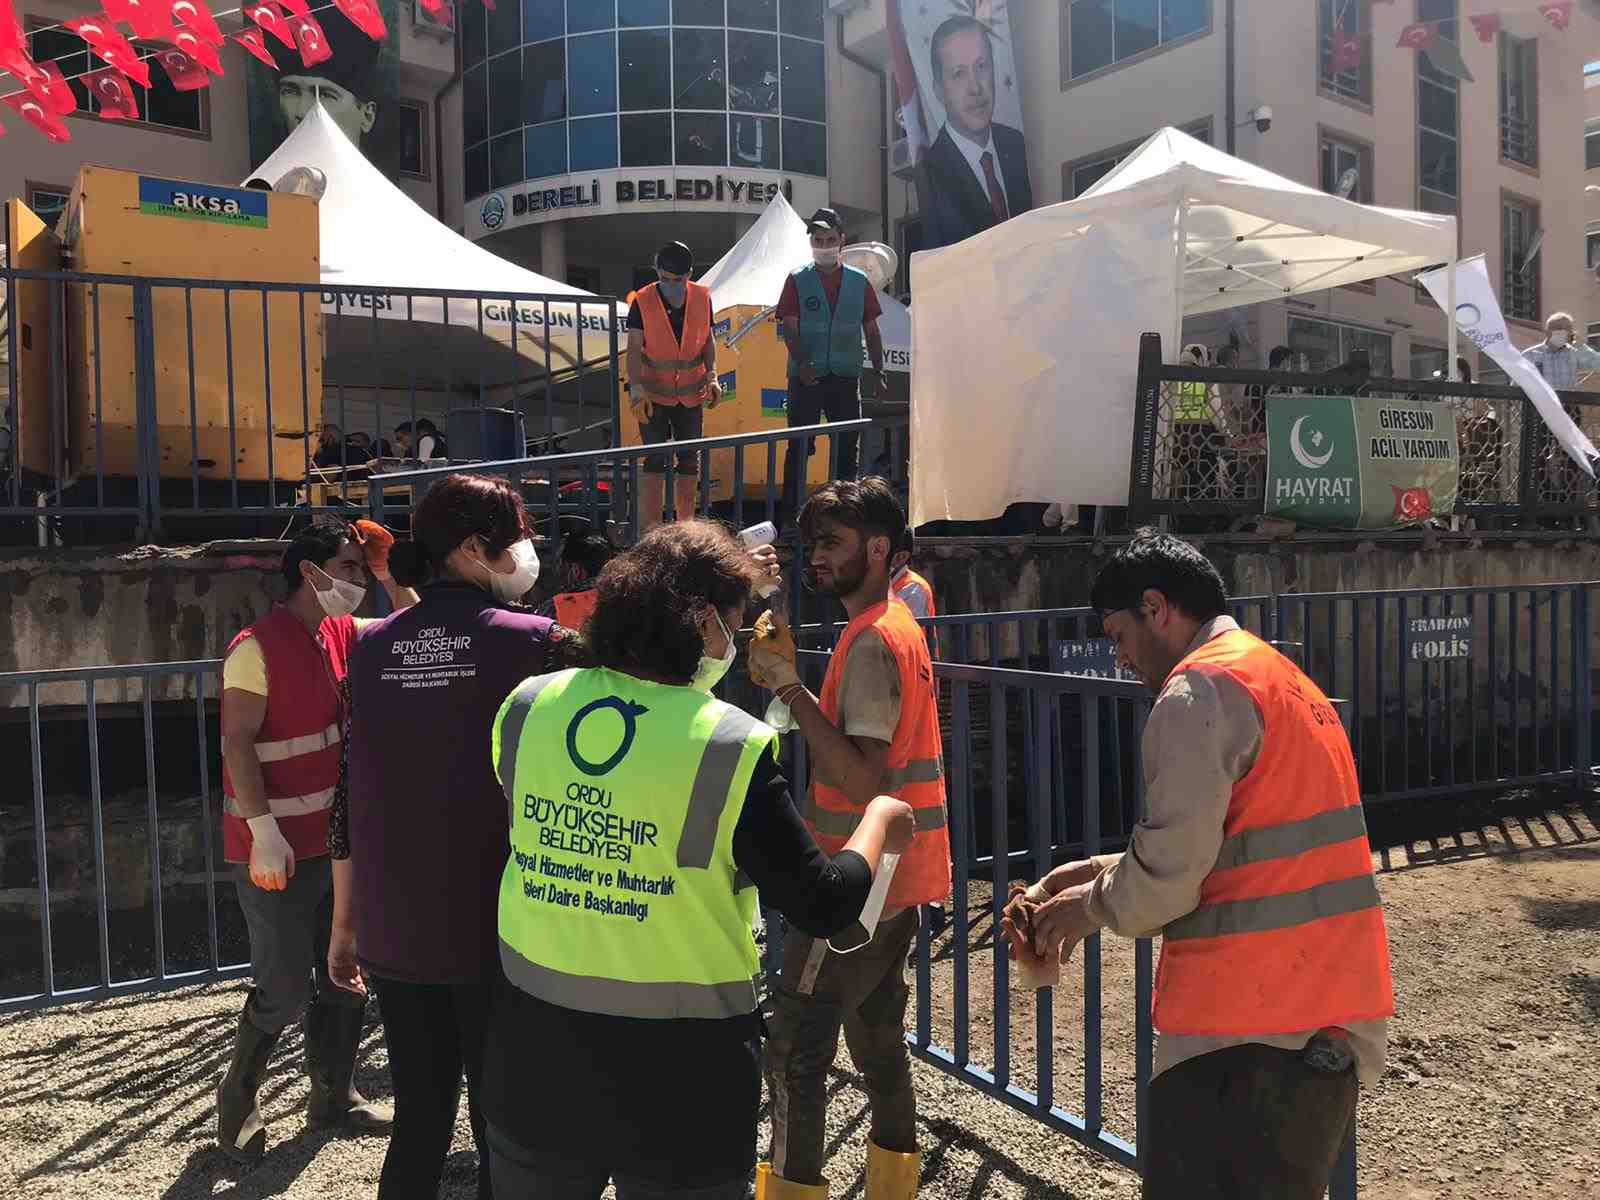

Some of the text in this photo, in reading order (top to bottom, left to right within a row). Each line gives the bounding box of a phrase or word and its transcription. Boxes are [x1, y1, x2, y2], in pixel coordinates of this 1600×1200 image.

[173, 192, 240, 214] aksa
[512, 175, 793, 216] DERELİ BELEDİYESİ
[1379, 403, 1434, 430] GİRESUN
[1371, 434, 1450, 459] ACİL YARDIM
[1276, 478, 1352, 497] HAYRAT
[418, 626, 446, 639] ORDU
[1411, 633, 1469, 659] POLİS
[566, 782, 612, 808] ORDU
[524, 793, 658, 847] BÜYÜKŞEHİR
[540, 827, 632, 863] BELEDİYESİ
[540, 855, 594, 884] Hizmetler
[597, 871, 613, 887] ve
[617, 869, 676, 896] Muhtarlık
[547, 884, 580, 908] Daire
